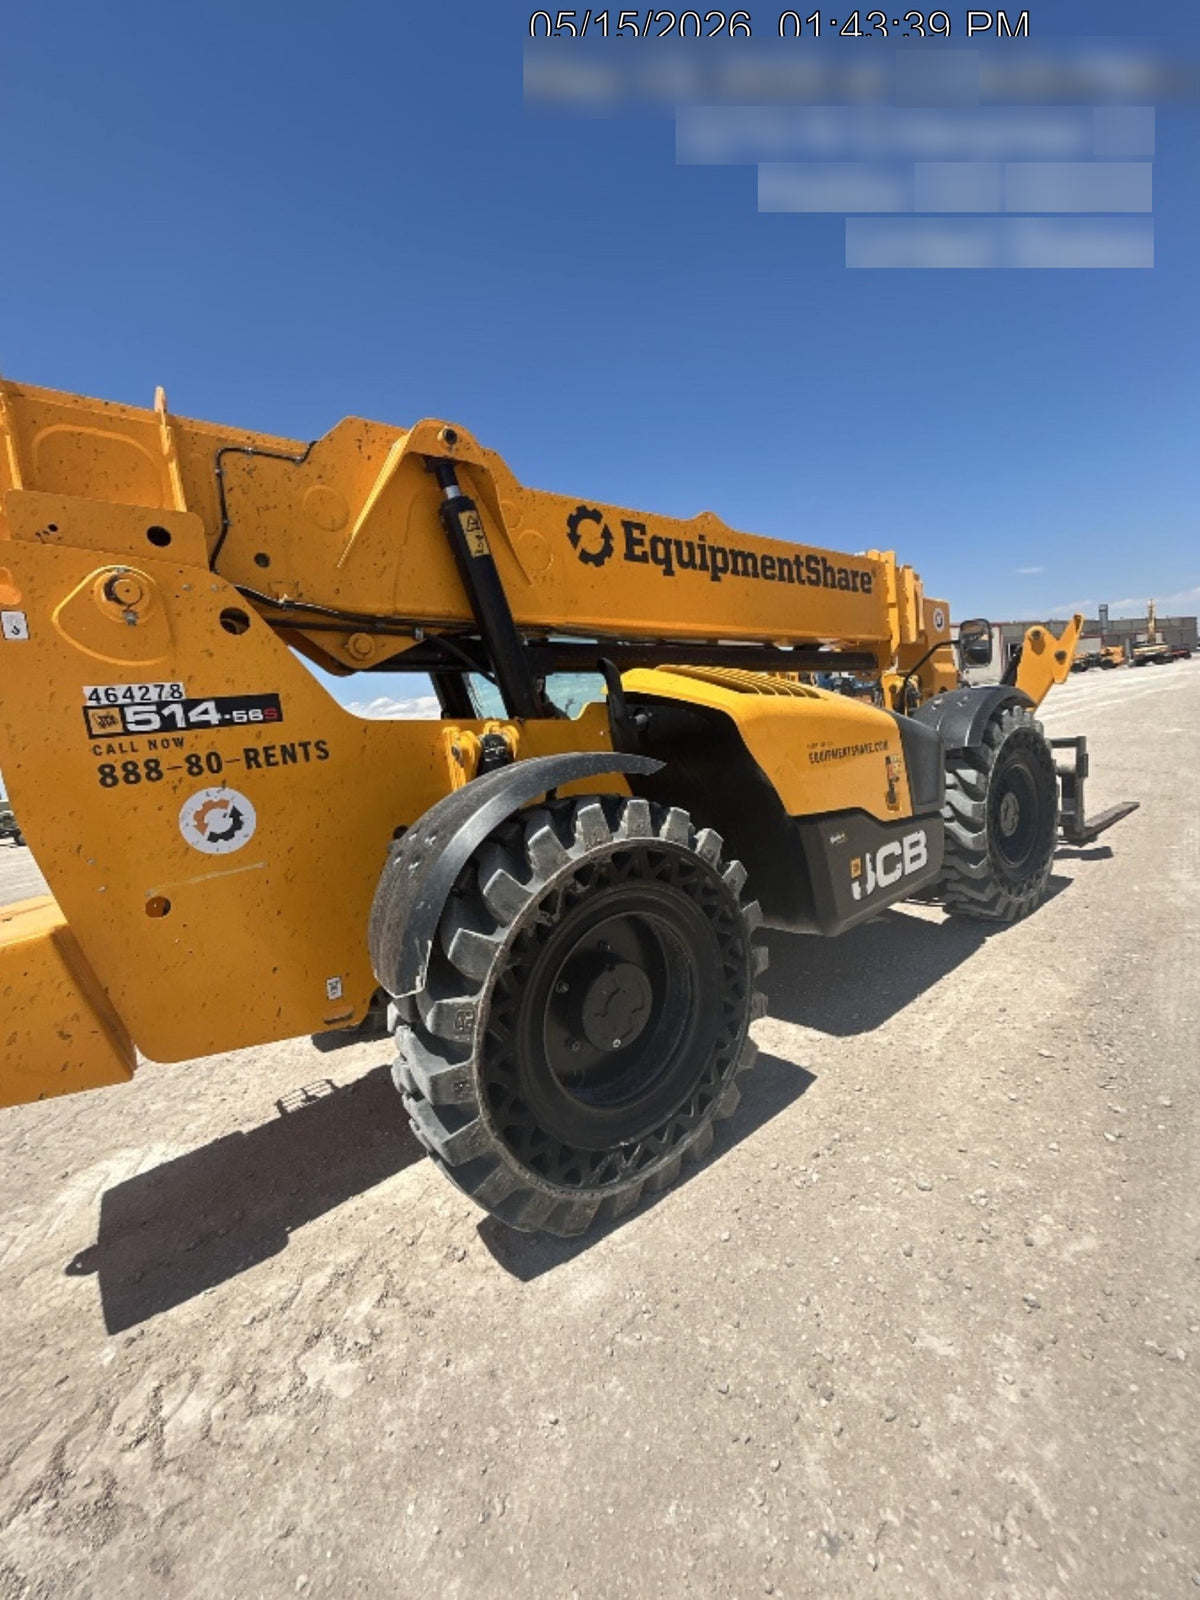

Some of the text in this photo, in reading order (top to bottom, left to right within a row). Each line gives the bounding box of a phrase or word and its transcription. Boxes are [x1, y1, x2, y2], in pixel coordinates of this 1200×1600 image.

[88, 683, 184, 705] 464278
[92, 737, 185, 756] CALL NOW
[851, 829, 928, 900] JCB
